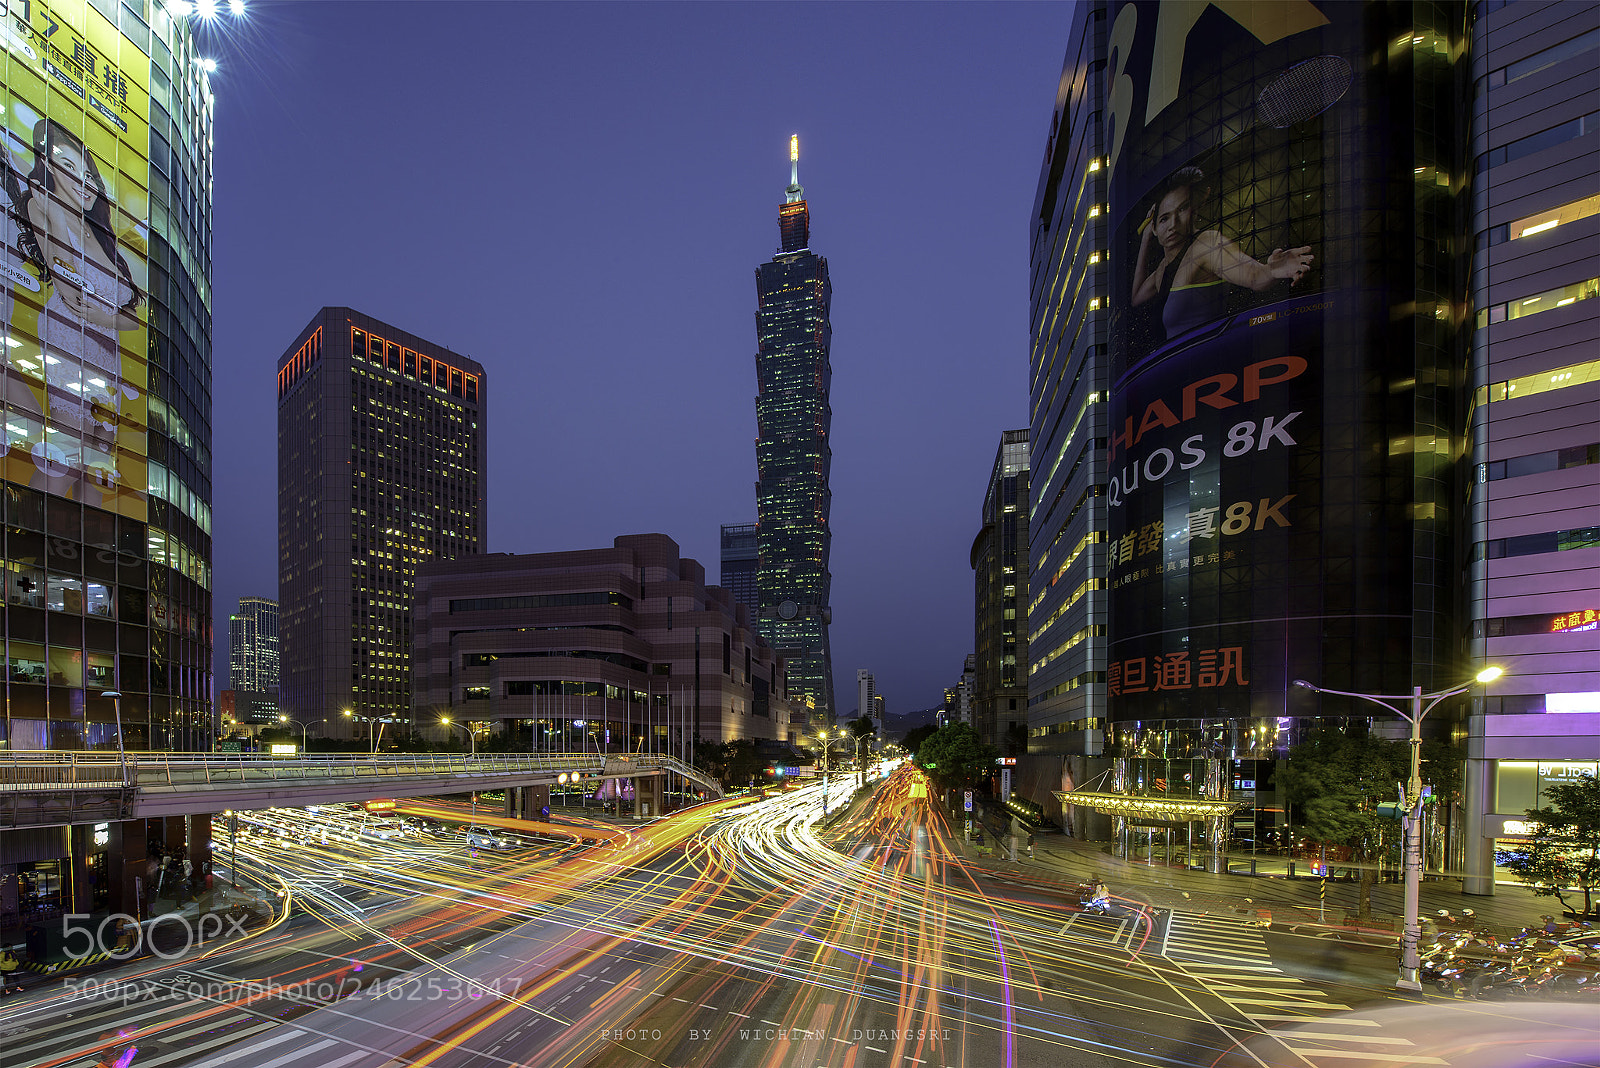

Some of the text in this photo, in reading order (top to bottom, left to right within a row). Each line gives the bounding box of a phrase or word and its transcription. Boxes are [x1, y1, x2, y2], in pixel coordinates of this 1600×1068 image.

[1107, 411, 1303, 508] QUOS 8K
[1180, 494, 1297, 545] 真8K
[1107, 646, 1249, 698] 震旦通訊
